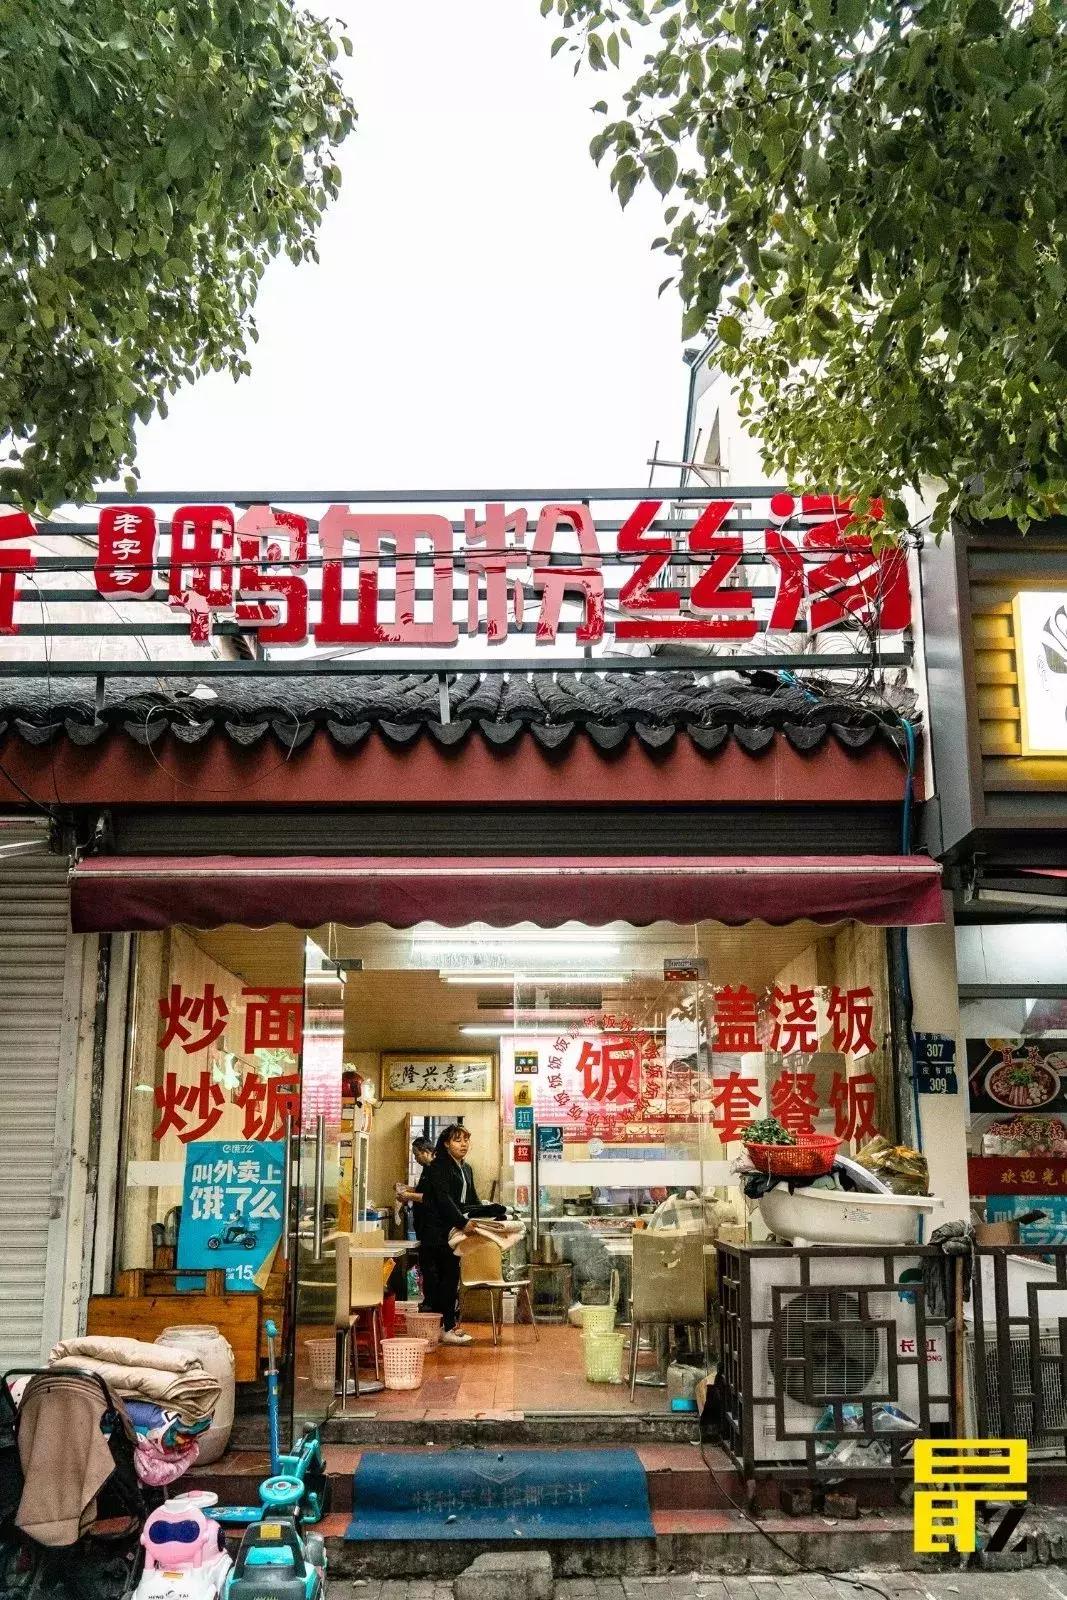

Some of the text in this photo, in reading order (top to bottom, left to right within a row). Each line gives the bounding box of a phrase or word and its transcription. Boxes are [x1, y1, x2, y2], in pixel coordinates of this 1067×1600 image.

[108, 512, 143, 586] 老字号
[168, 493, 912, 647] 鸭血粉丝汤
[157, 983, 303, 1056] 炒面
[711, 984, 878, 1055] 盖浇饭
[926, 1043, 944, 1057] 307
[575, 1040, 640, 1102] 饭
[929, 1077, 947, 1091] 309
[151, 1071, 303, 1145] 炒饭
[711, 1071, 880, 1143] 套餐饭
[189, 1185, 282, 1221] 饿了么
[191, 1160, 282, 1185] 叫外卖上
[235, 1264, 254, 1280] 15
